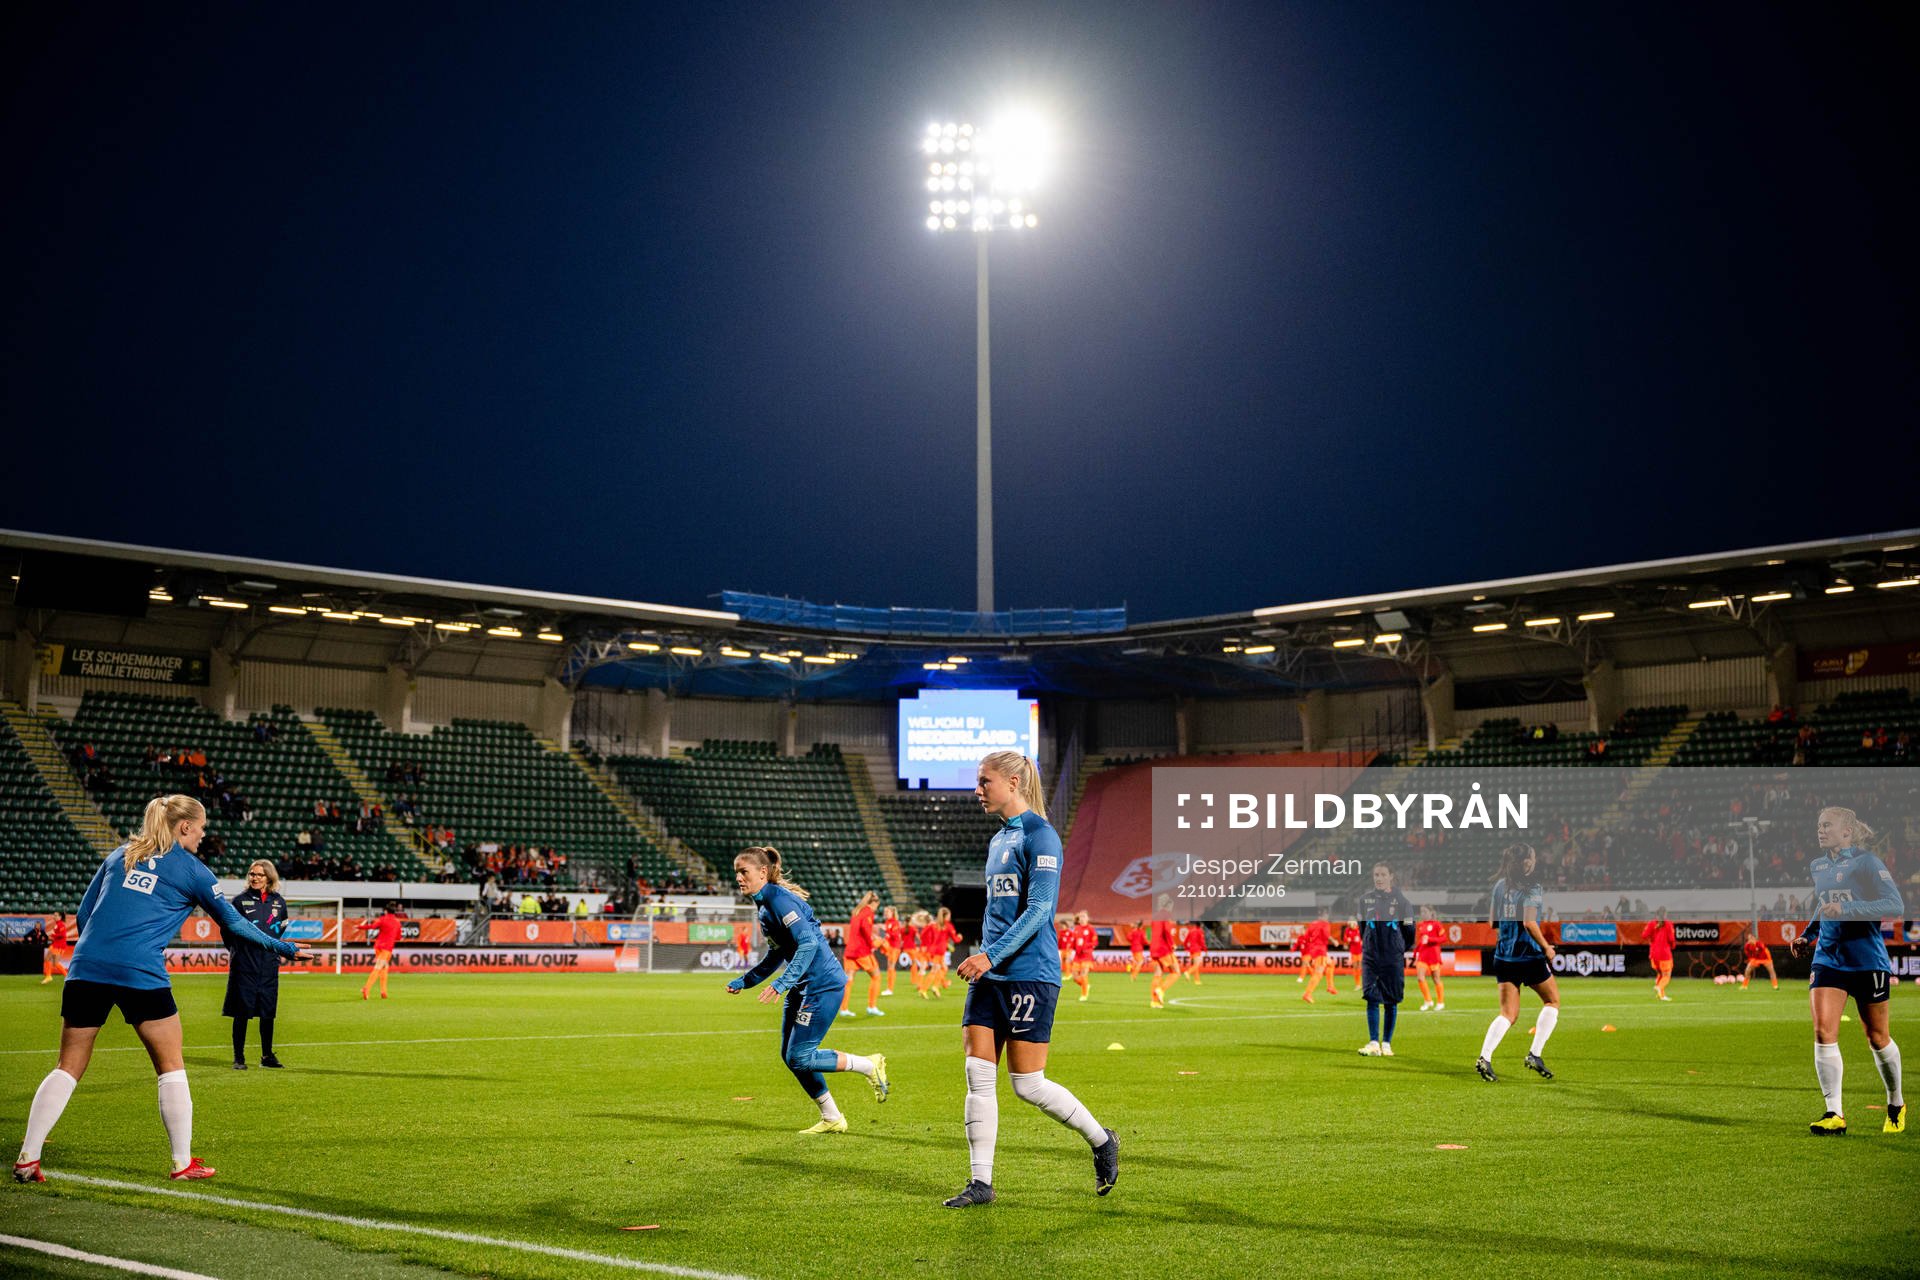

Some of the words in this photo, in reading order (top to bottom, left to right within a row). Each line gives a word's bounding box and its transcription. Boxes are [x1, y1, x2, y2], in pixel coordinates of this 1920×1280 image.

[72, 648, 93, 662] LEX
[96, 650, 183, 670] SCHOENMAKER
[80, 663, 175, 681] FAMILIETRIBUNE
[907, 717, 963, 728] WELKOM
[127, 873, 152, 889] 5G
[995, 878, 1015, 893] 5G
[1263, 928, 1288, 941] ING
[1676, 926, 1719, 939] bitvavo
[182, 953, 229, 967] KANS
[409, 953, 579, 968] ONSORANJE.NL/QUIZ
[1010, 993, 1035, 1022] 22
